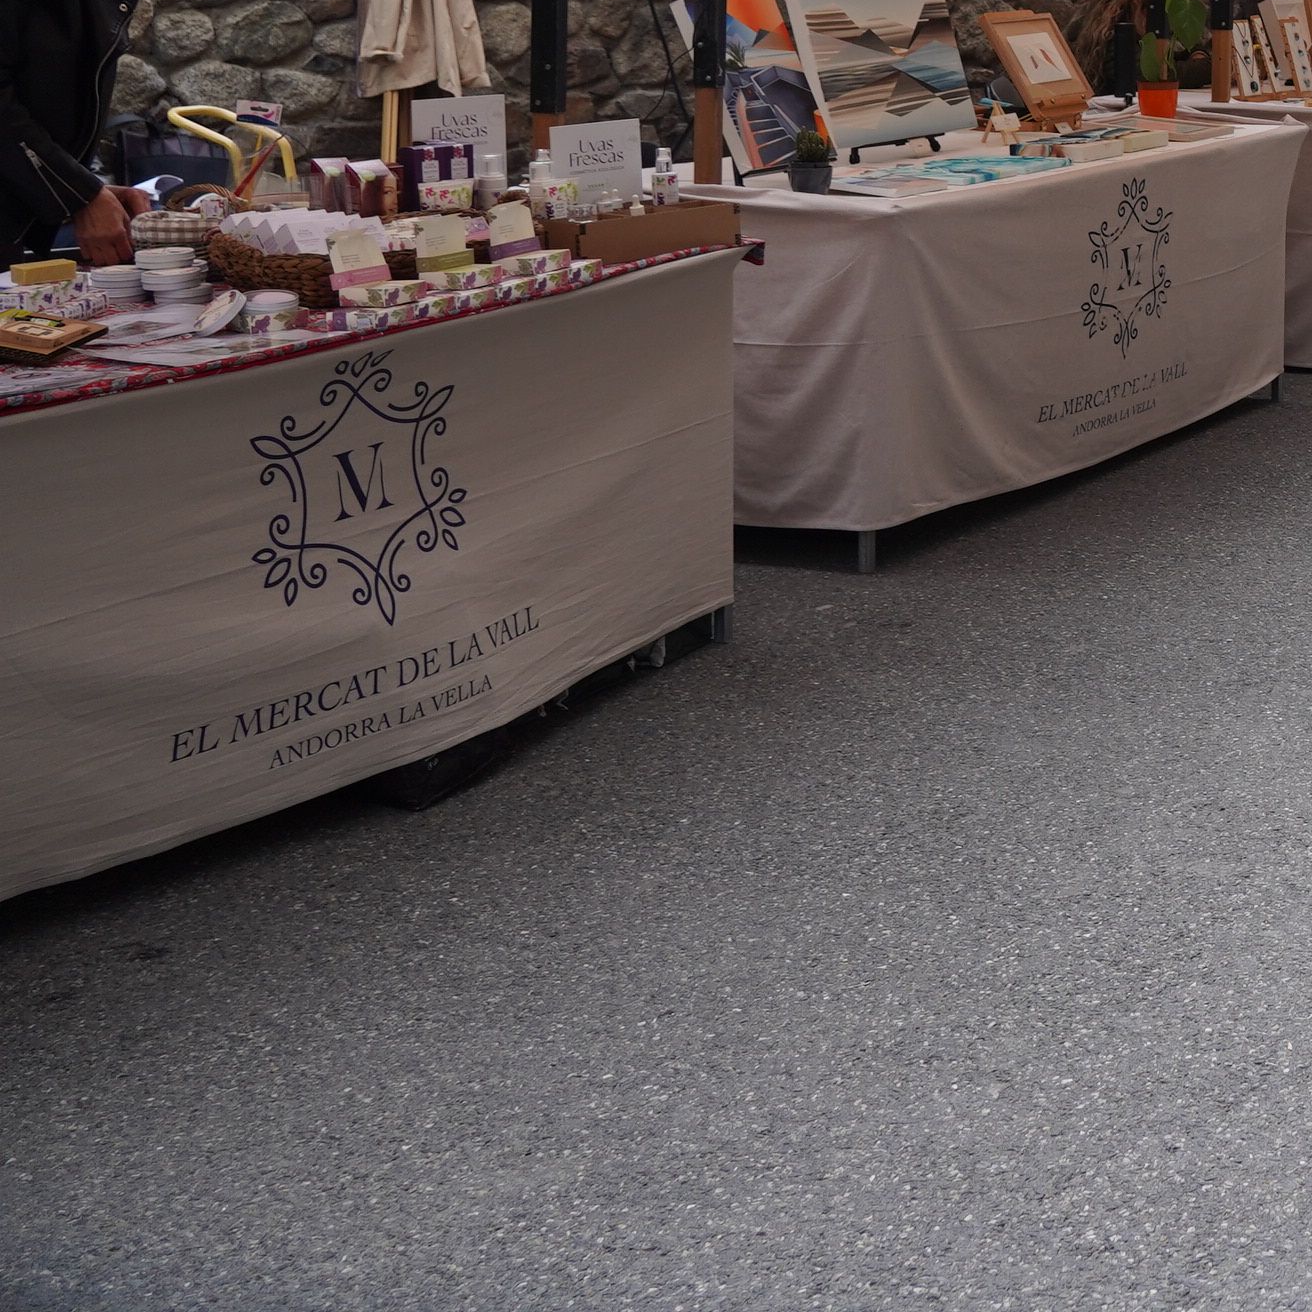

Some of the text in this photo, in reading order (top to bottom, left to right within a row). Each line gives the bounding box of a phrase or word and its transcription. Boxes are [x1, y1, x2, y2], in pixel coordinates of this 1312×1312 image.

[442, 113, 479, 127] Uvas
[431, 126, 488, 140] Frescas
[579, 139, 614, 154] Uvas
[569, 151, 625, 168] Frescas
[1037, 404, 1058, 424] EL
[1060, 384, 1120, 418] MERCAT
[1072, 414, 1118, 437] ANDORRA
[332, 441, 395, 522] M
[170, 606, 541, 763] EL MERCAT DE LA VALL
[268, 674, 494, 770] ANDORRA LA VELLA
